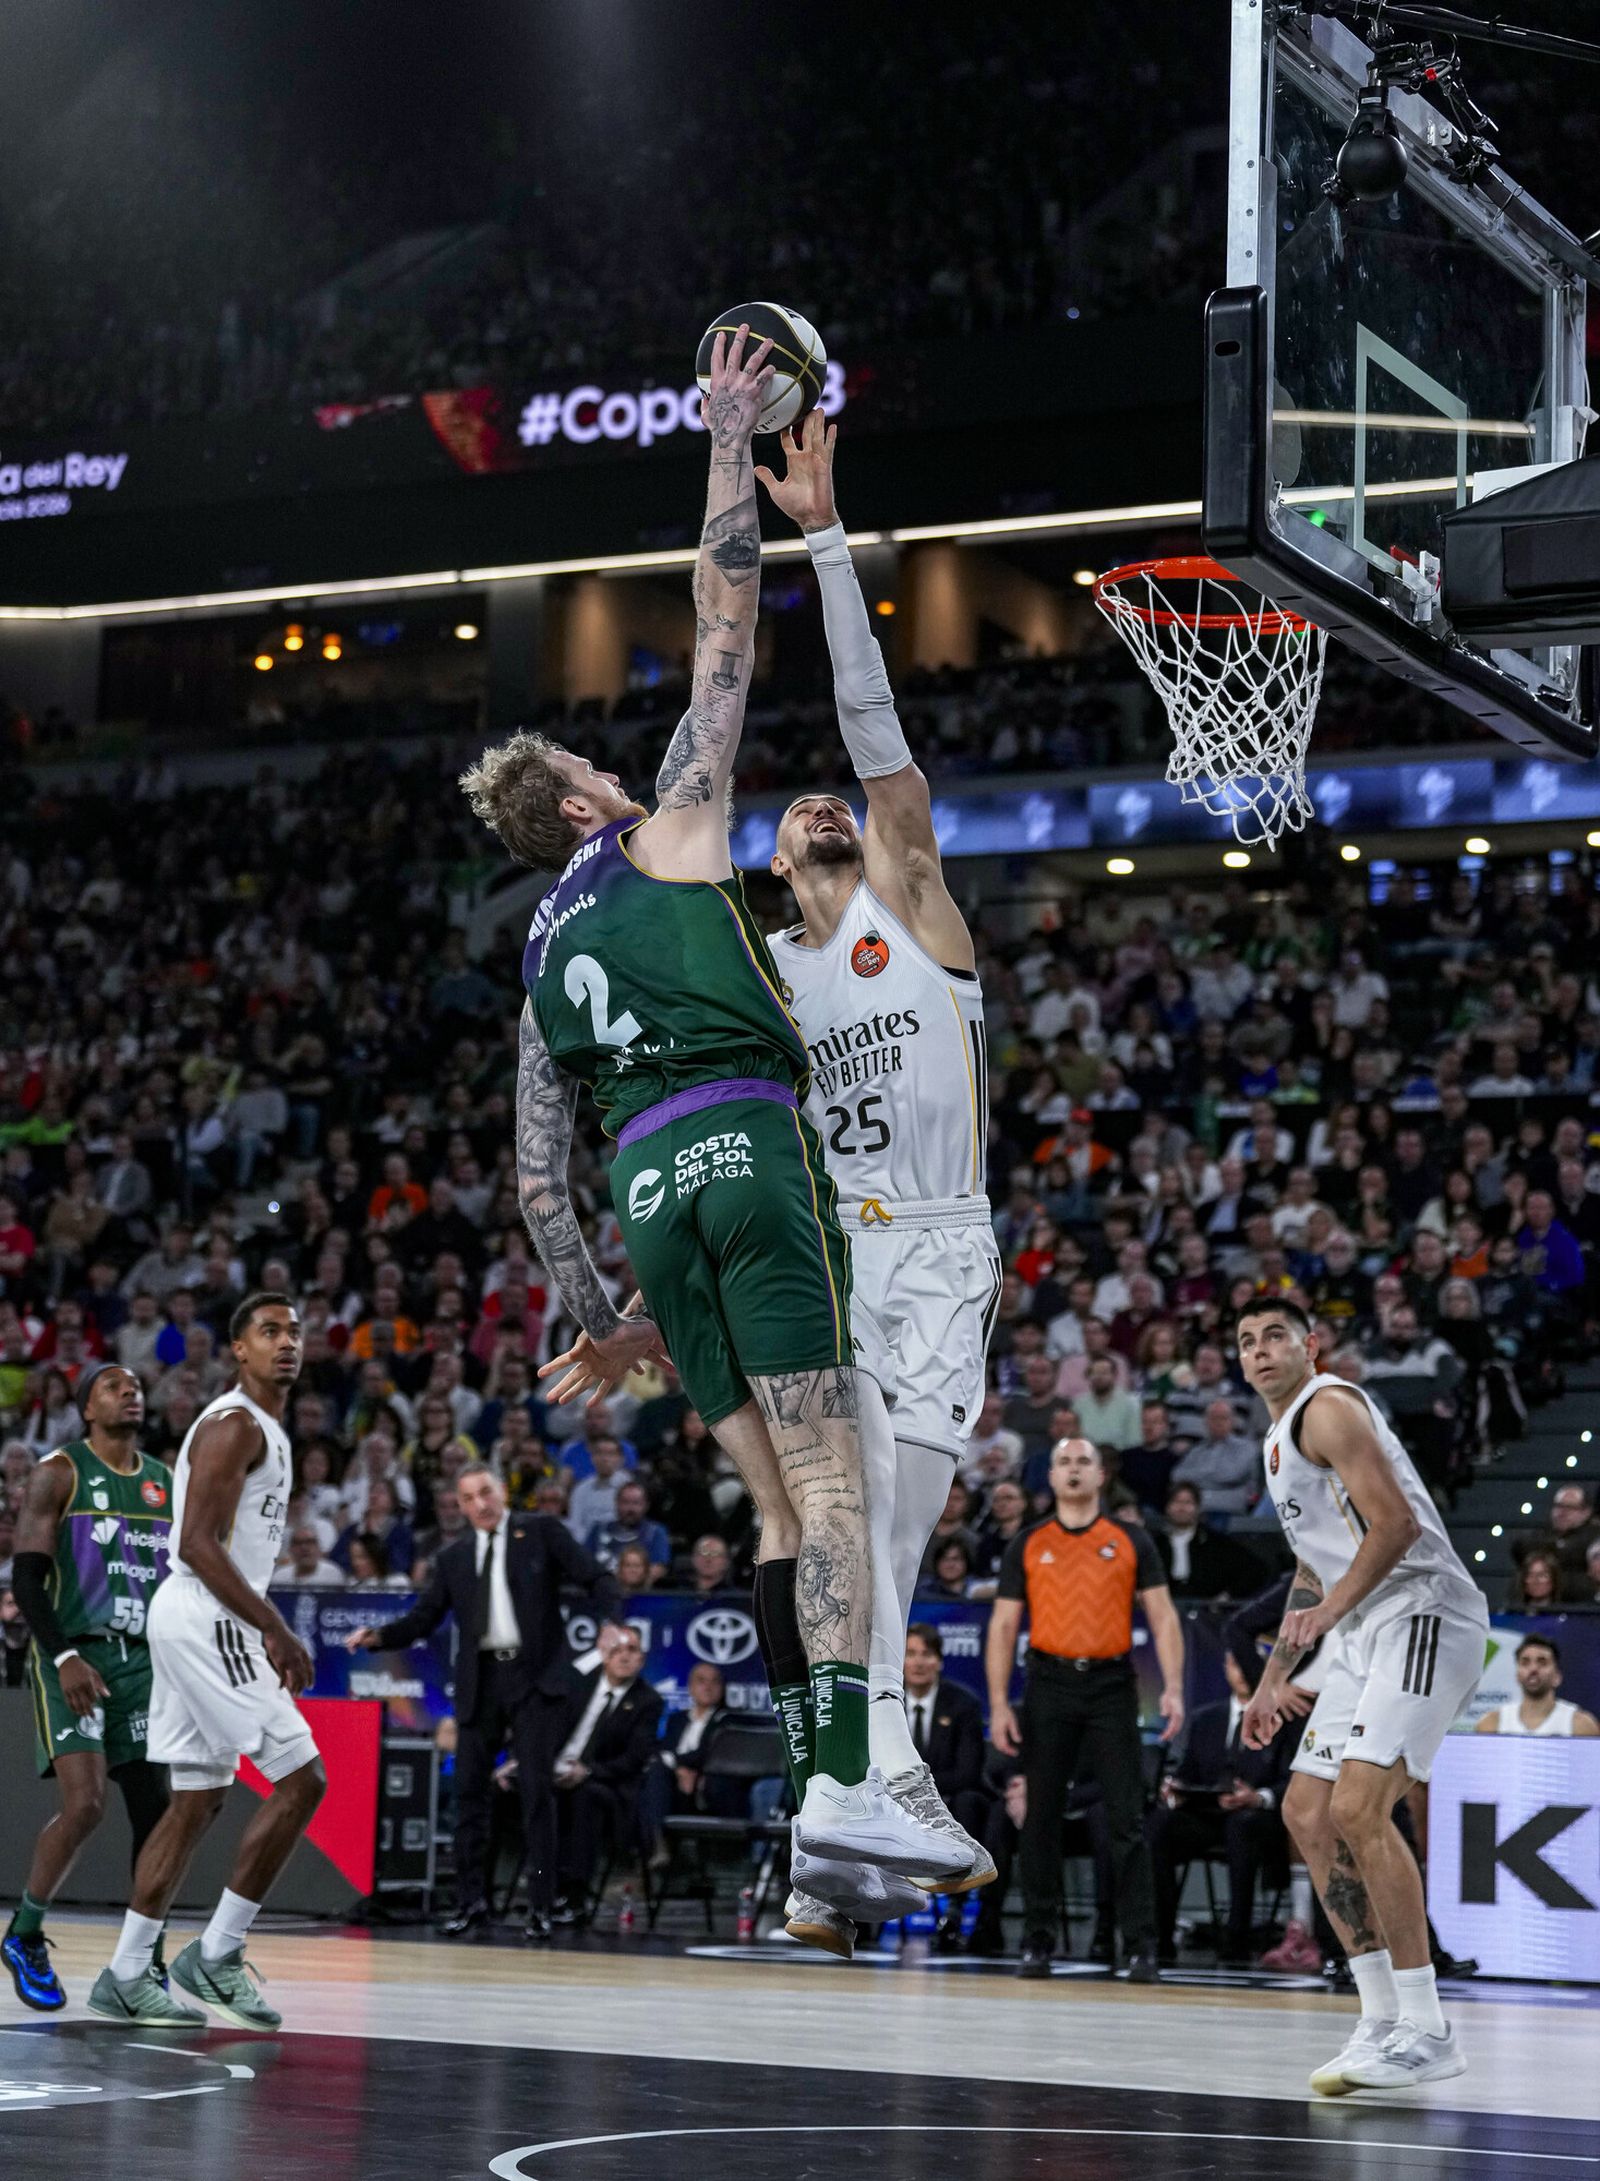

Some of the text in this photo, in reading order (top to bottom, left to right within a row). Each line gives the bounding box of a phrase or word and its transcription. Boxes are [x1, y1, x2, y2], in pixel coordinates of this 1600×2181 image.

[64, 452, 128, 491] Rey
[564, 954, 643, 1047] 2
[807, 1009, 920, 1072] mirates
[814, 1045, 902, 1099] FLY BETTER
[674, 1132, 752, 1167] COSTA
[825, 1095, 891, 1156] 25
[674, 1149, 754, 1184] DEL SOL
[676, 1164, 754, 1200] MÁLAGA
[110, 1597, 145, 1635] 55
[815, 1675, 833, 1728] UNICAJA
[781, 1698, 809, 1764] UNICAJA
